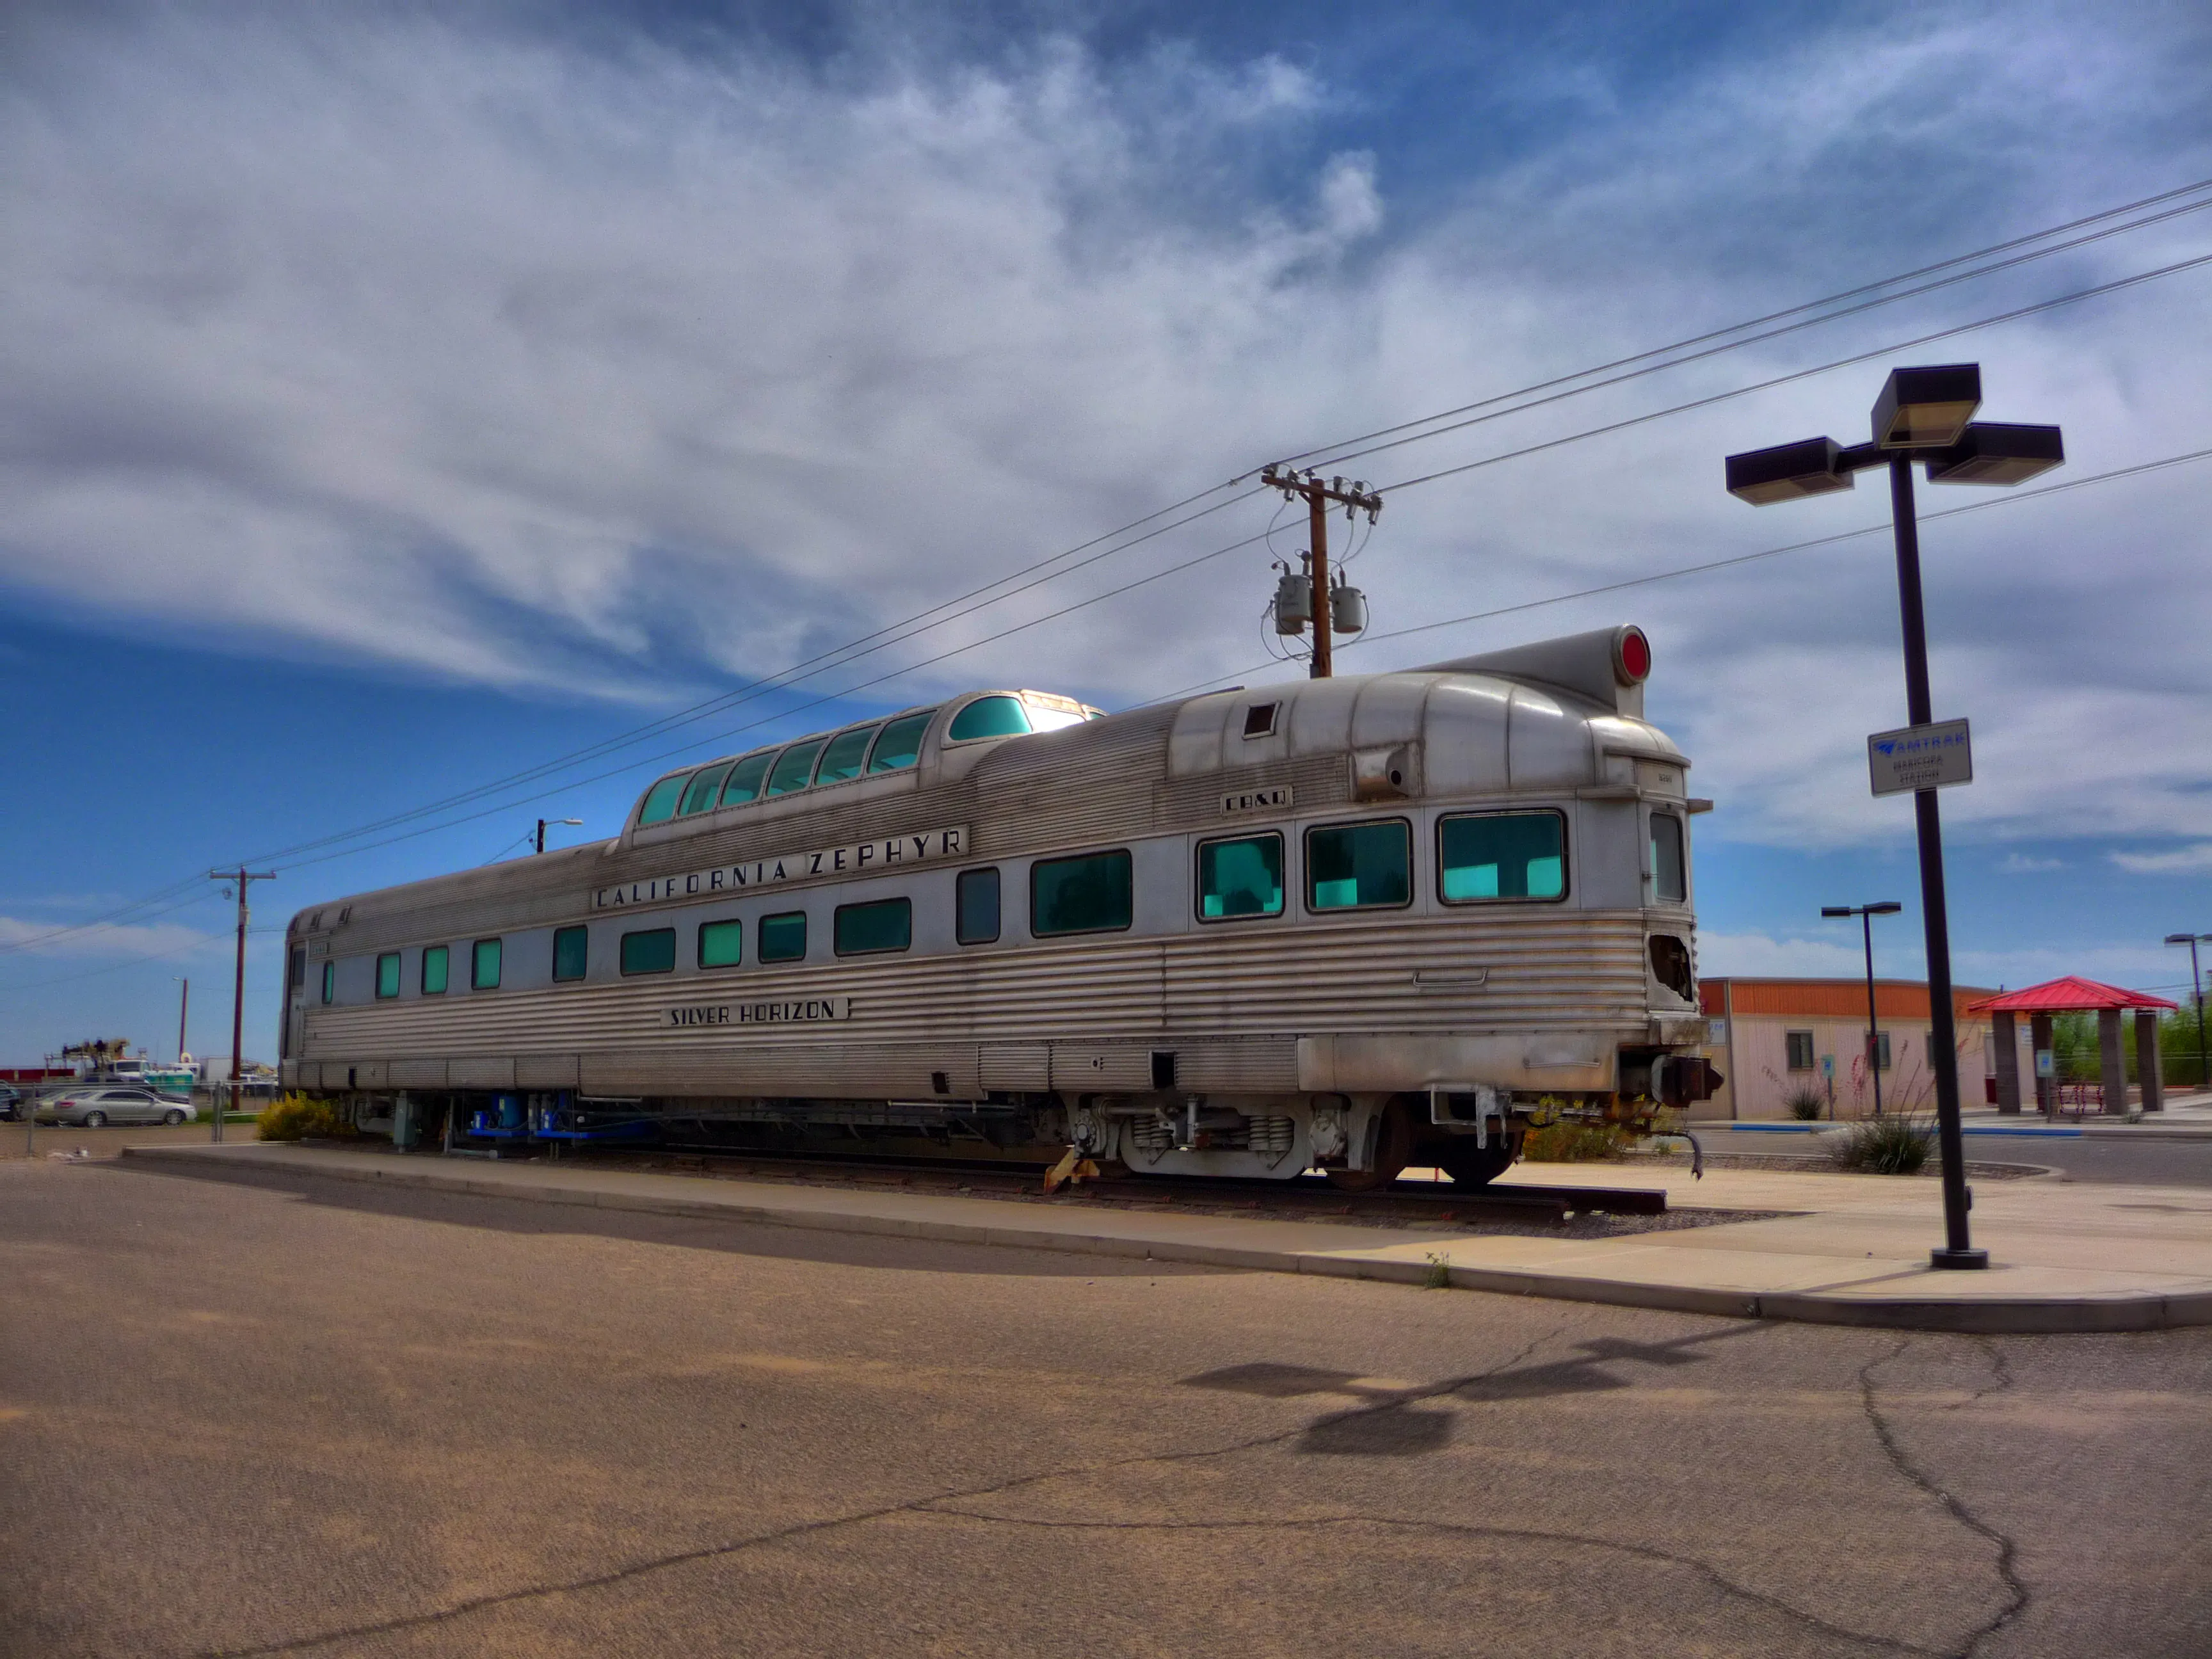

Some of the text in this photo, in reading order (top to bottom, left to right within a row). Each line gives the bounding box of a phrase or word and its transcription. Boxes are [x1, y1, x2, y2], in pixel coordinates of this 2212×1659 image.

[1896, 732, 1965, 753] AMTRAK
[1893, 755, 1943, 772] MARICOPA
[1899, 769, 1939, 785] STATION
[597, 830, 959, 908] CALIFORNIA ZEPHYR
[671, 1000, 834, 1025] SILVER HORIZON
